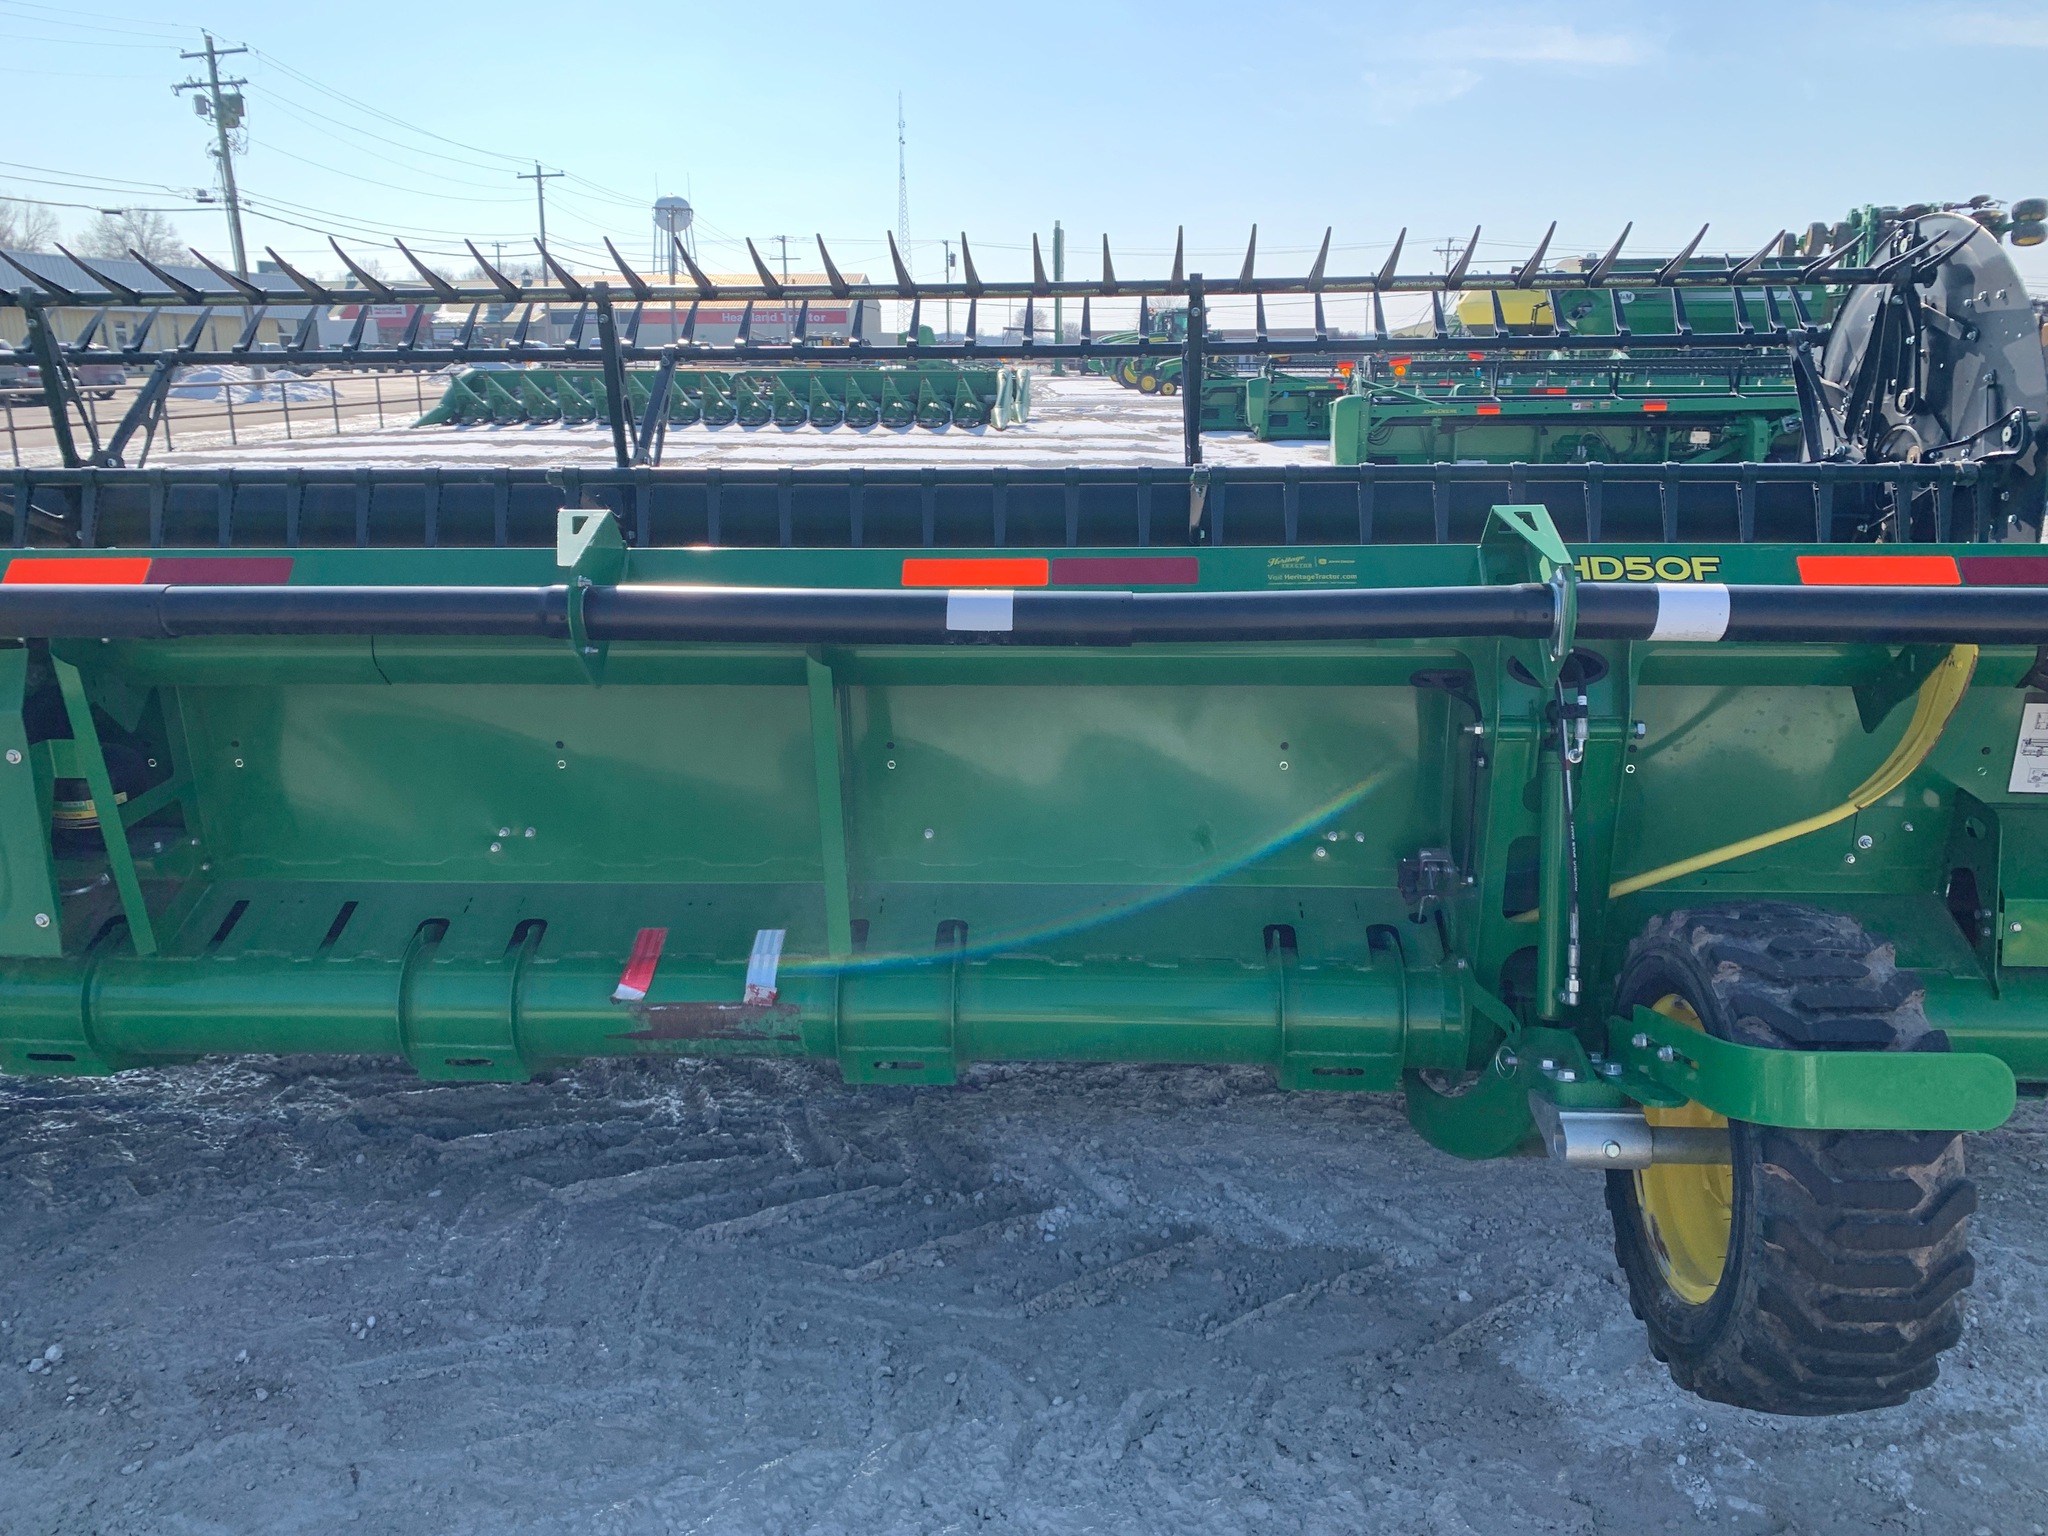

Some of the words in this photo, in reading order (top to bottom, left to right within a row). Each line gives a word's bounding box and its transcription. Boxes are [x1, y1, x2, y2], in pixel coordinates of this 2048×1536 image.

[722, 312, 777, 322] Healand
[780, 312, 826, 322] Trtor
[1267, 555, 1306, 568] Heritage
[1284, 573, 1358, 581] HeritageTractor.com
